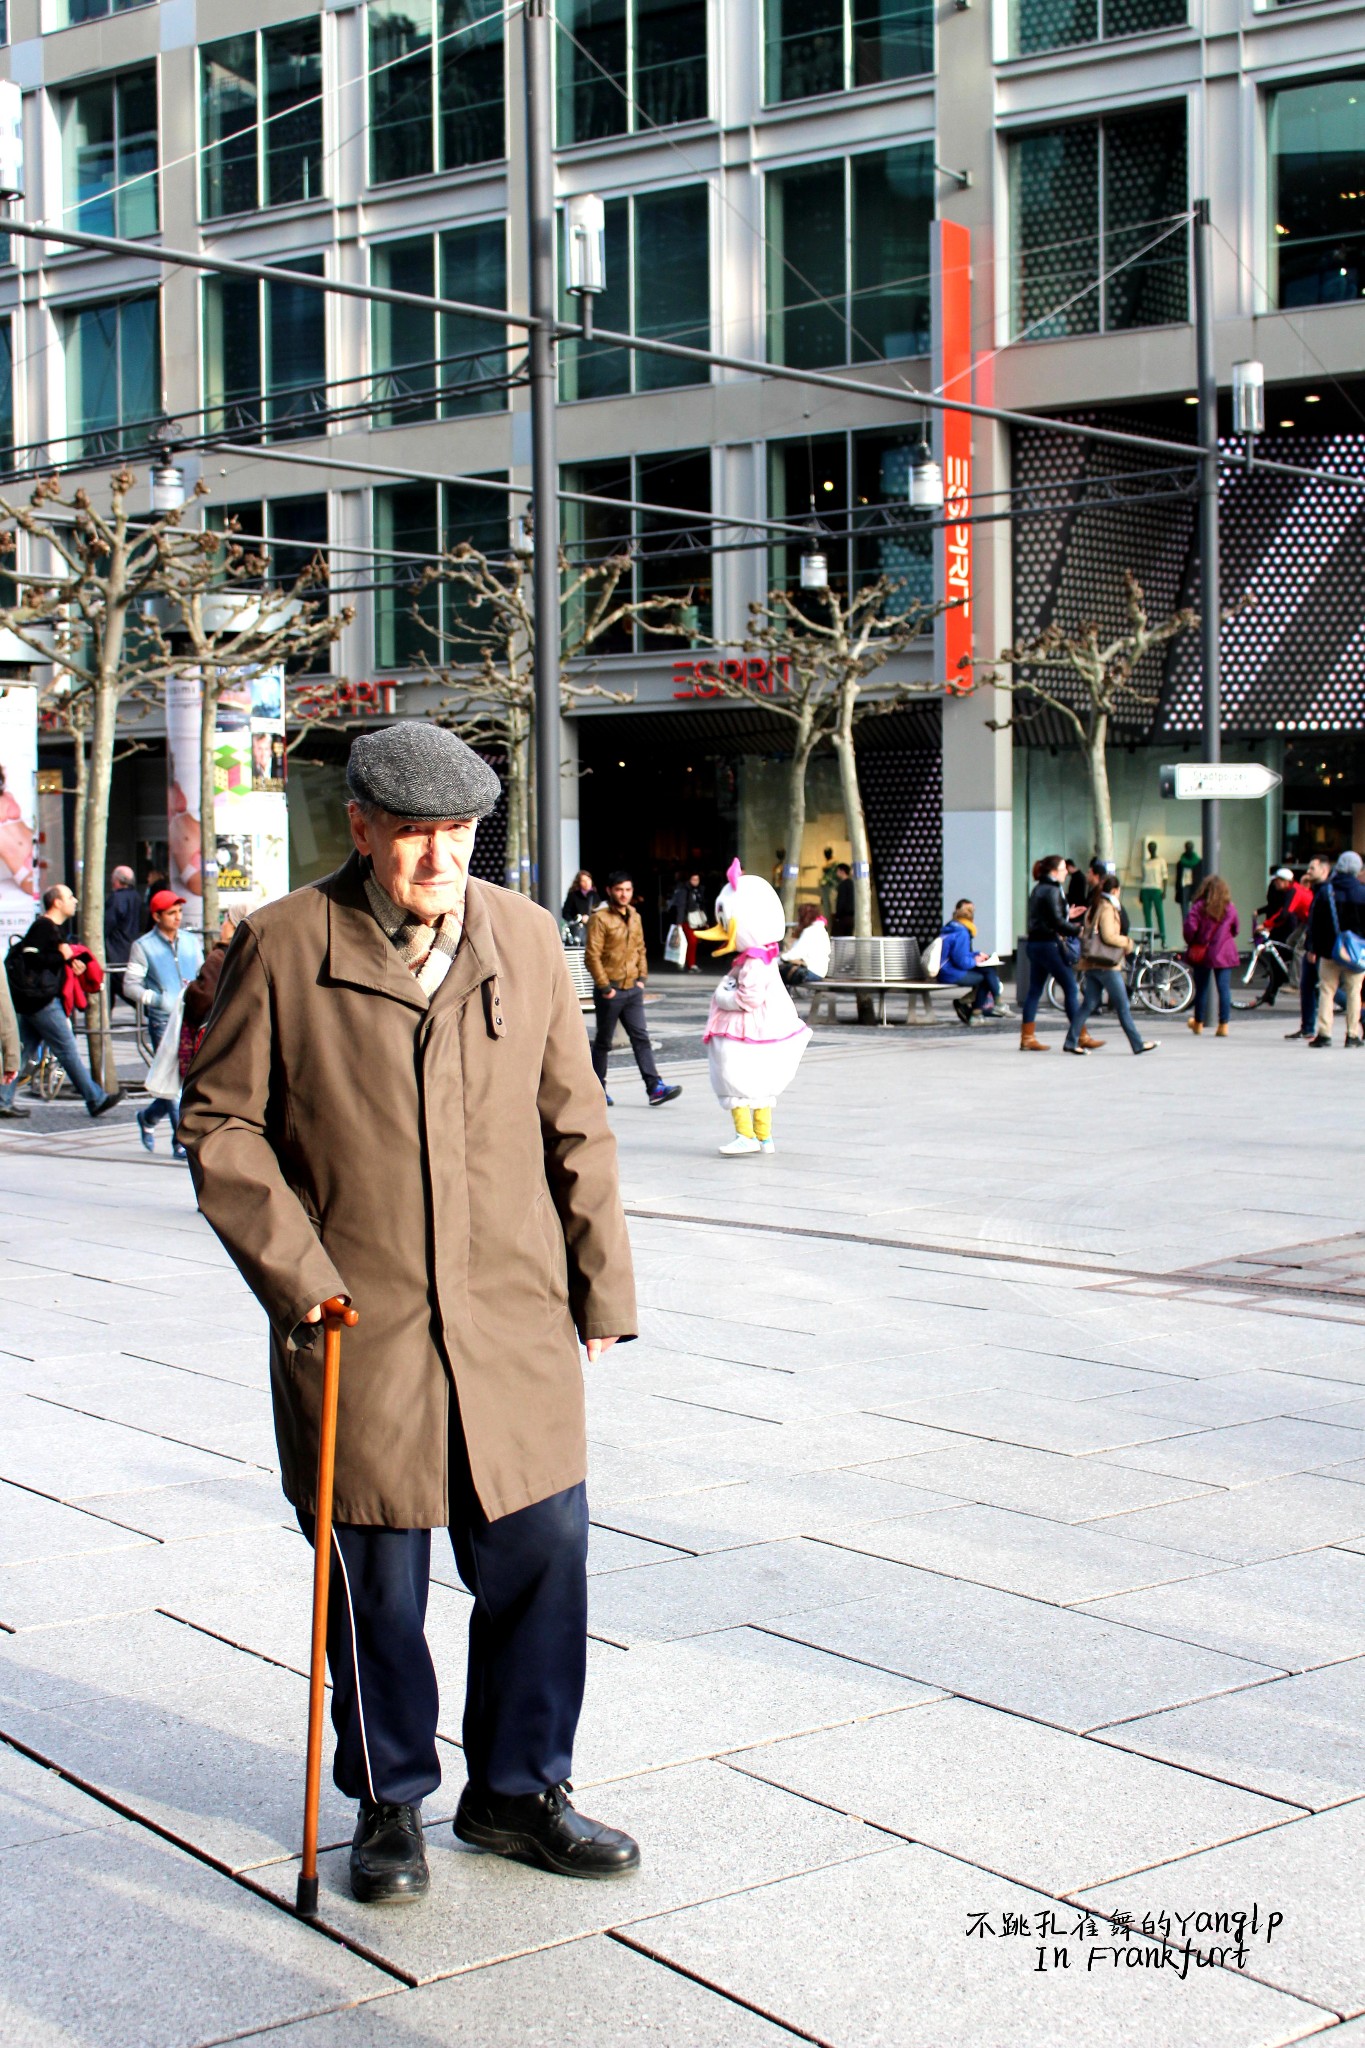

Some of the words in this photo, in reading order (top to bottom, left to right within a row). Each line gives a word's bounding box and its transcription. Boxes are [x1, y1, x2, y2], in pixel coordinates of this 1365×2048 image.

[946, 455, 970, 618] ESPRIT
[295, 679, 402, 719] ESPRIT
[672, 656, 793, 699] ESPRIT
